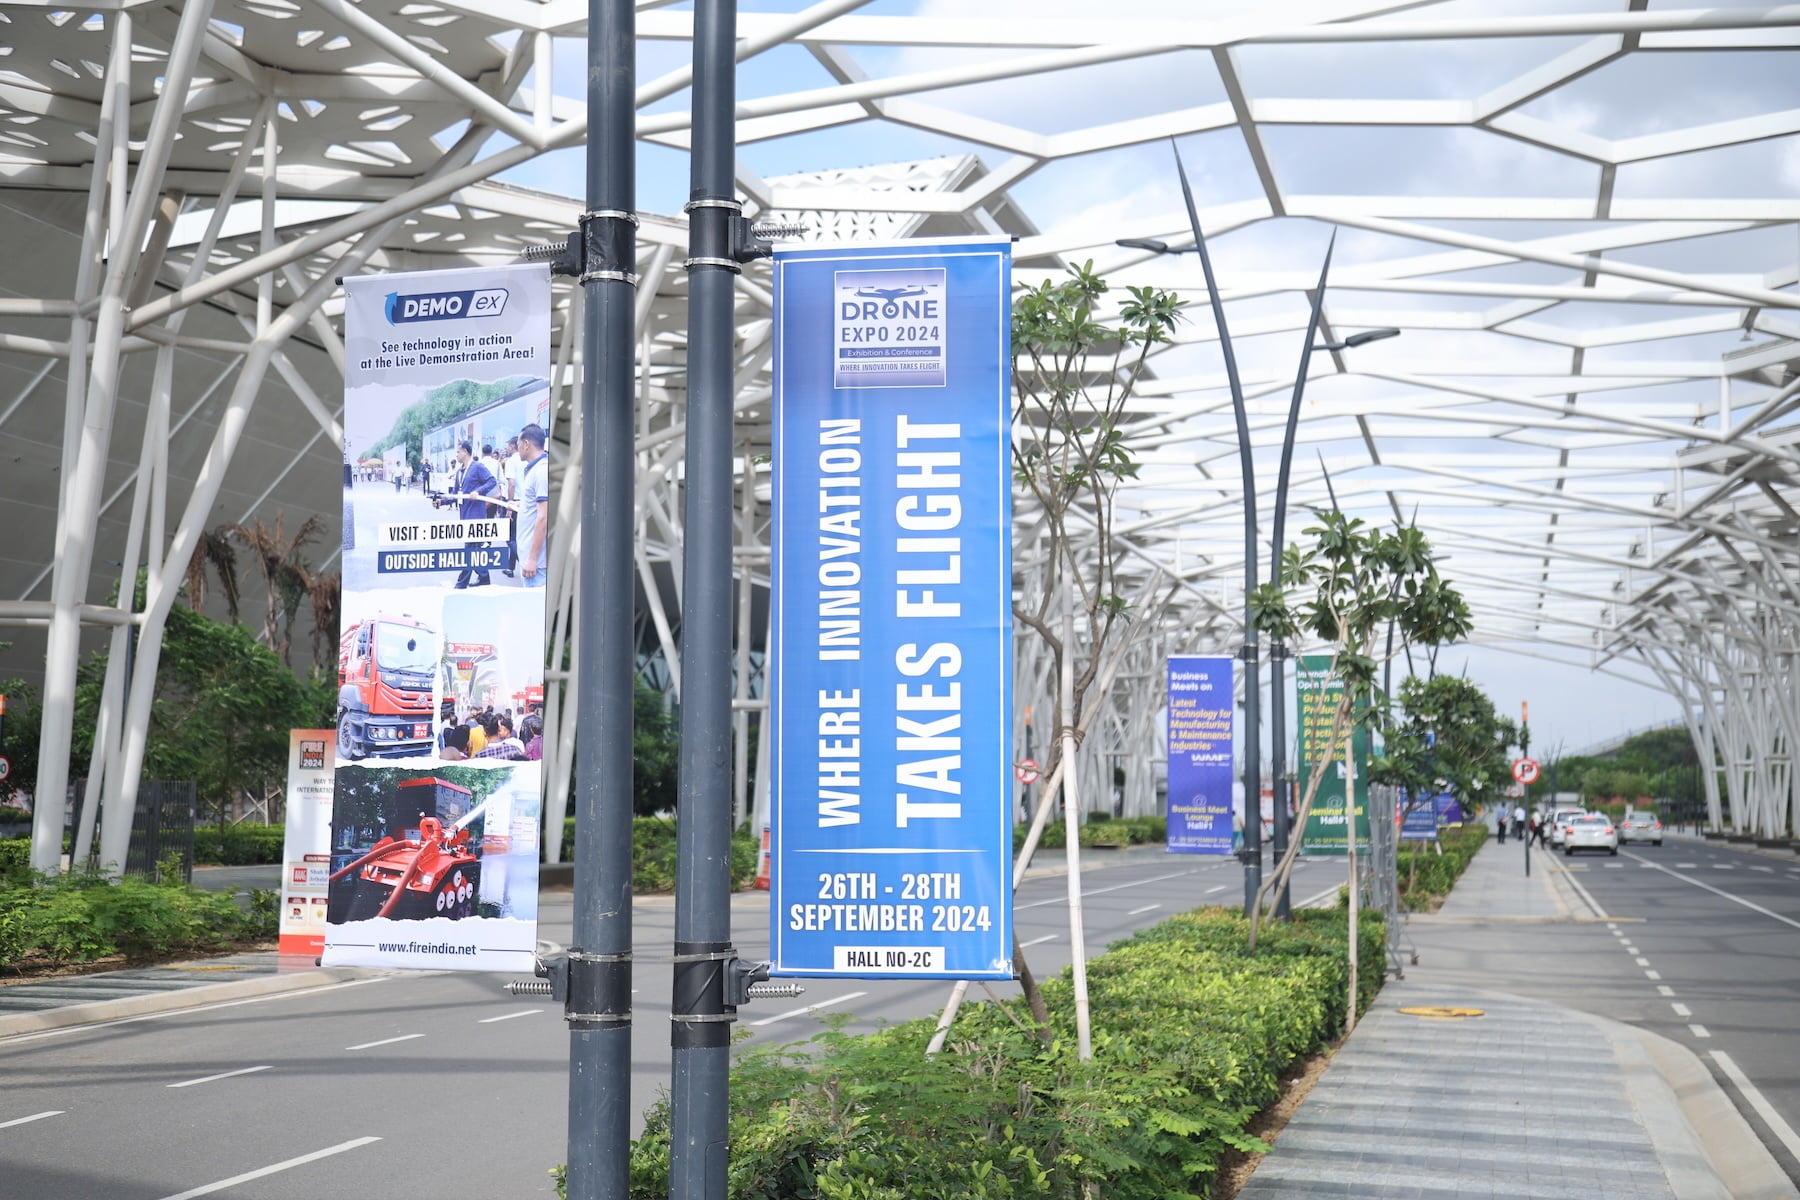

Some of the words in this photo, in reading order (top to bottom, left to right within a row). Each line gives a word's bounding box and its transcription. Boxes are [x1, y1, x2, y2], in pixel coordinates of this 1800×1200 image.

[404, 296, 462, 318] DEMO
[476, 296, 501, 310] ex
[842, 300, 938, 320] DRONE
[842, 326, 888, 342] EXPO
[896, 326, 939, 341] 2024
[382, 342, 400, 353] See
[402, 337, 460, 351] technology
[464, 336, 474, 347] in
[479, 334, 512, 346] action
[360, 358, 372, 369] at
[375, 356, 392, 368] the
[396, 355, 415, 367] Live
[420, 349, 499, 365] Demonstration
[503, 347, 534, 359] Area!
[848, 349, 883, 357] Exhibition
[891, 348, 933, 356] Conference
[920, 362, 940, 370] FLIGHT
[896, 414, 962, 617] FLIGHT
[389, 526, 419, 541] VISIT
[430, 524, 463, 540] DEMO
[468, 523, 498, 538] AREA
[818, 418, 861, 660] INNOVATION
[385, 553, 435, 570] OUTSIDE
[439, 552, 467, 568] HALL
[471, 551, 501, 567] NO-2
[1171, 672, 1208, 680] Business
[1171, 683, 1198, 691] Meets
[1170, 697, 1196, 707] Latest
[1171, 709, 1218, 720] Technology
[1219, 709, 1232, 718] for
[1170, 720, 1230, 731] Manufacturing
[896, 642, 962, 828] TAKES
[1170, 731, 1176, 739] &
[1179, 731, 1232, 740] Maintenance
[1170, 741, 1212, 750] Industries
[304, 759, 322, 767] 2024
[818, 688, 860, 828] WHERE
[1172, 805, 1206, 813] Business
[1208, 806, 1228, 814] Meet
[818, 873, 876, 899] 26TH
[902, 873, 960, 899] 28TH
[790, 904, 924, 931] SEPTEMBER
[932, 906, 991, 931] 2024
[379, 942, 476, 955] www.fireindia.net
[847, 952, 881, 967] HALL
[886, 952, 931, 967] NO-2C
